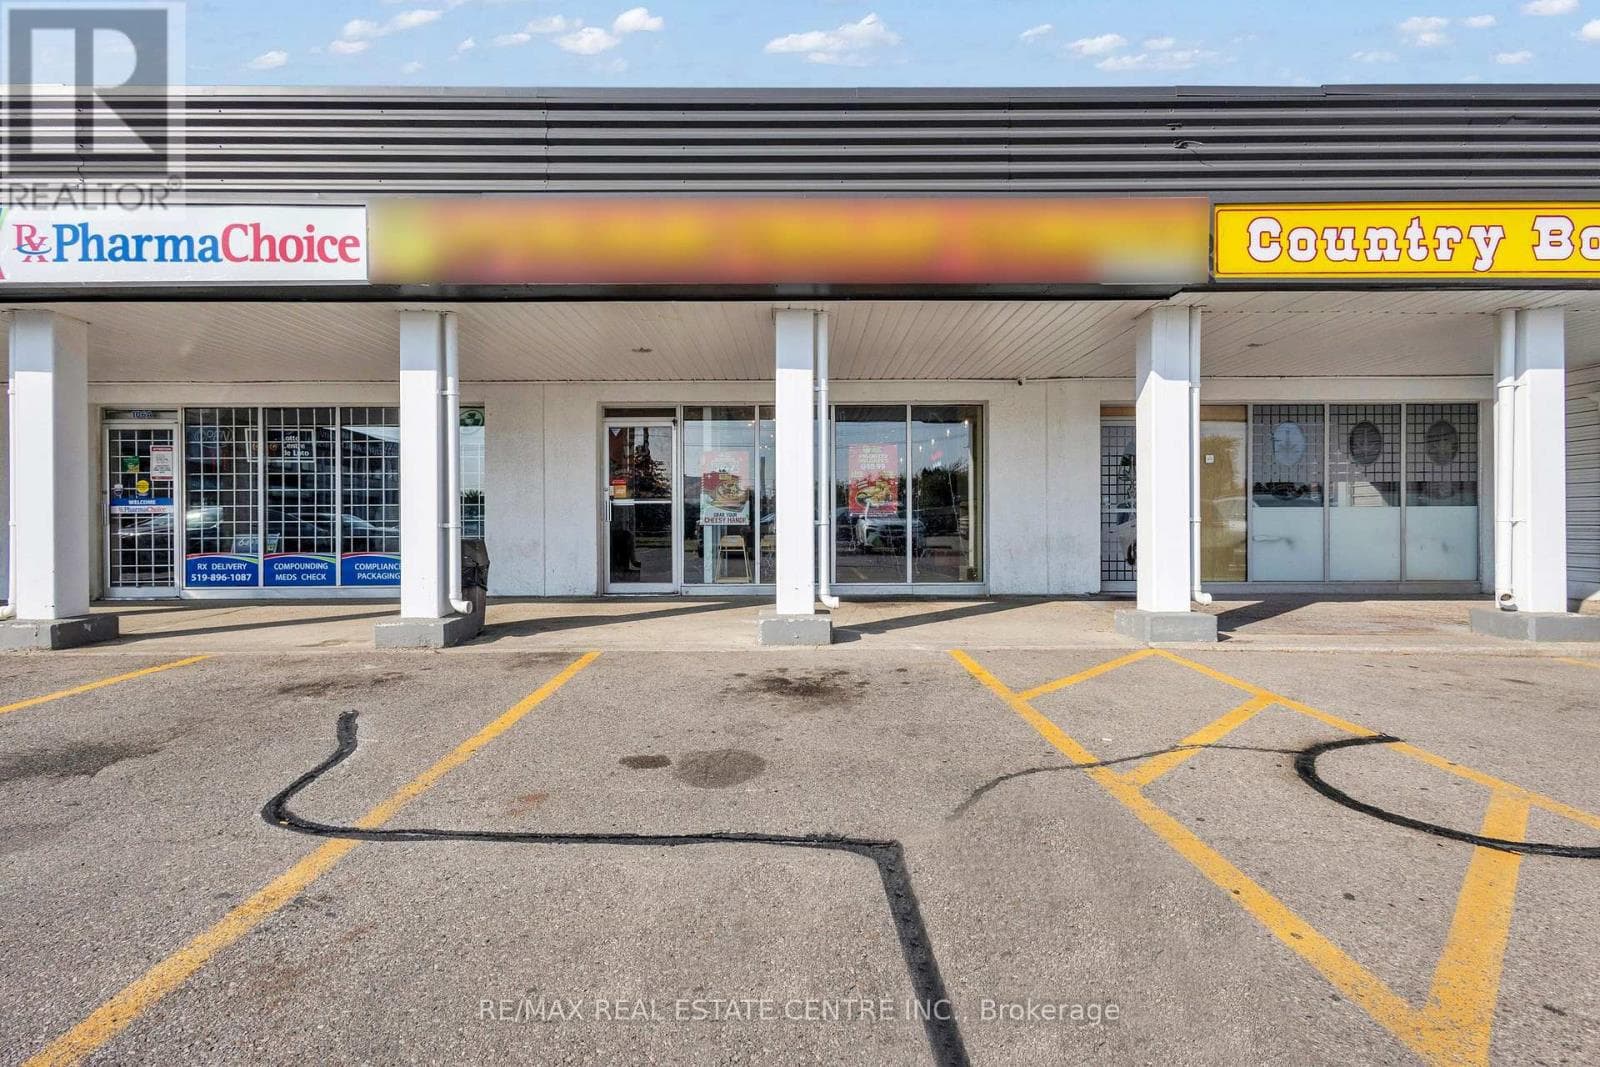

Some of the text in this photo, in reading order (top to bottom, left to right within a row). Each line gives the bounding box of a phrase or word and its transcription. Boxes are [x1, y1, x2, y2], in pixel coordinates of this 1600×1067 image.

[52, 222, 361, 263] PharmaChoice
[1247, 215, 1600, 272] Country Bo
[191, 573, 252, 582] 519-896-1087
[301, 573, 327, 581] CHECK
[357, 572, 400, 580] PACKAGING
